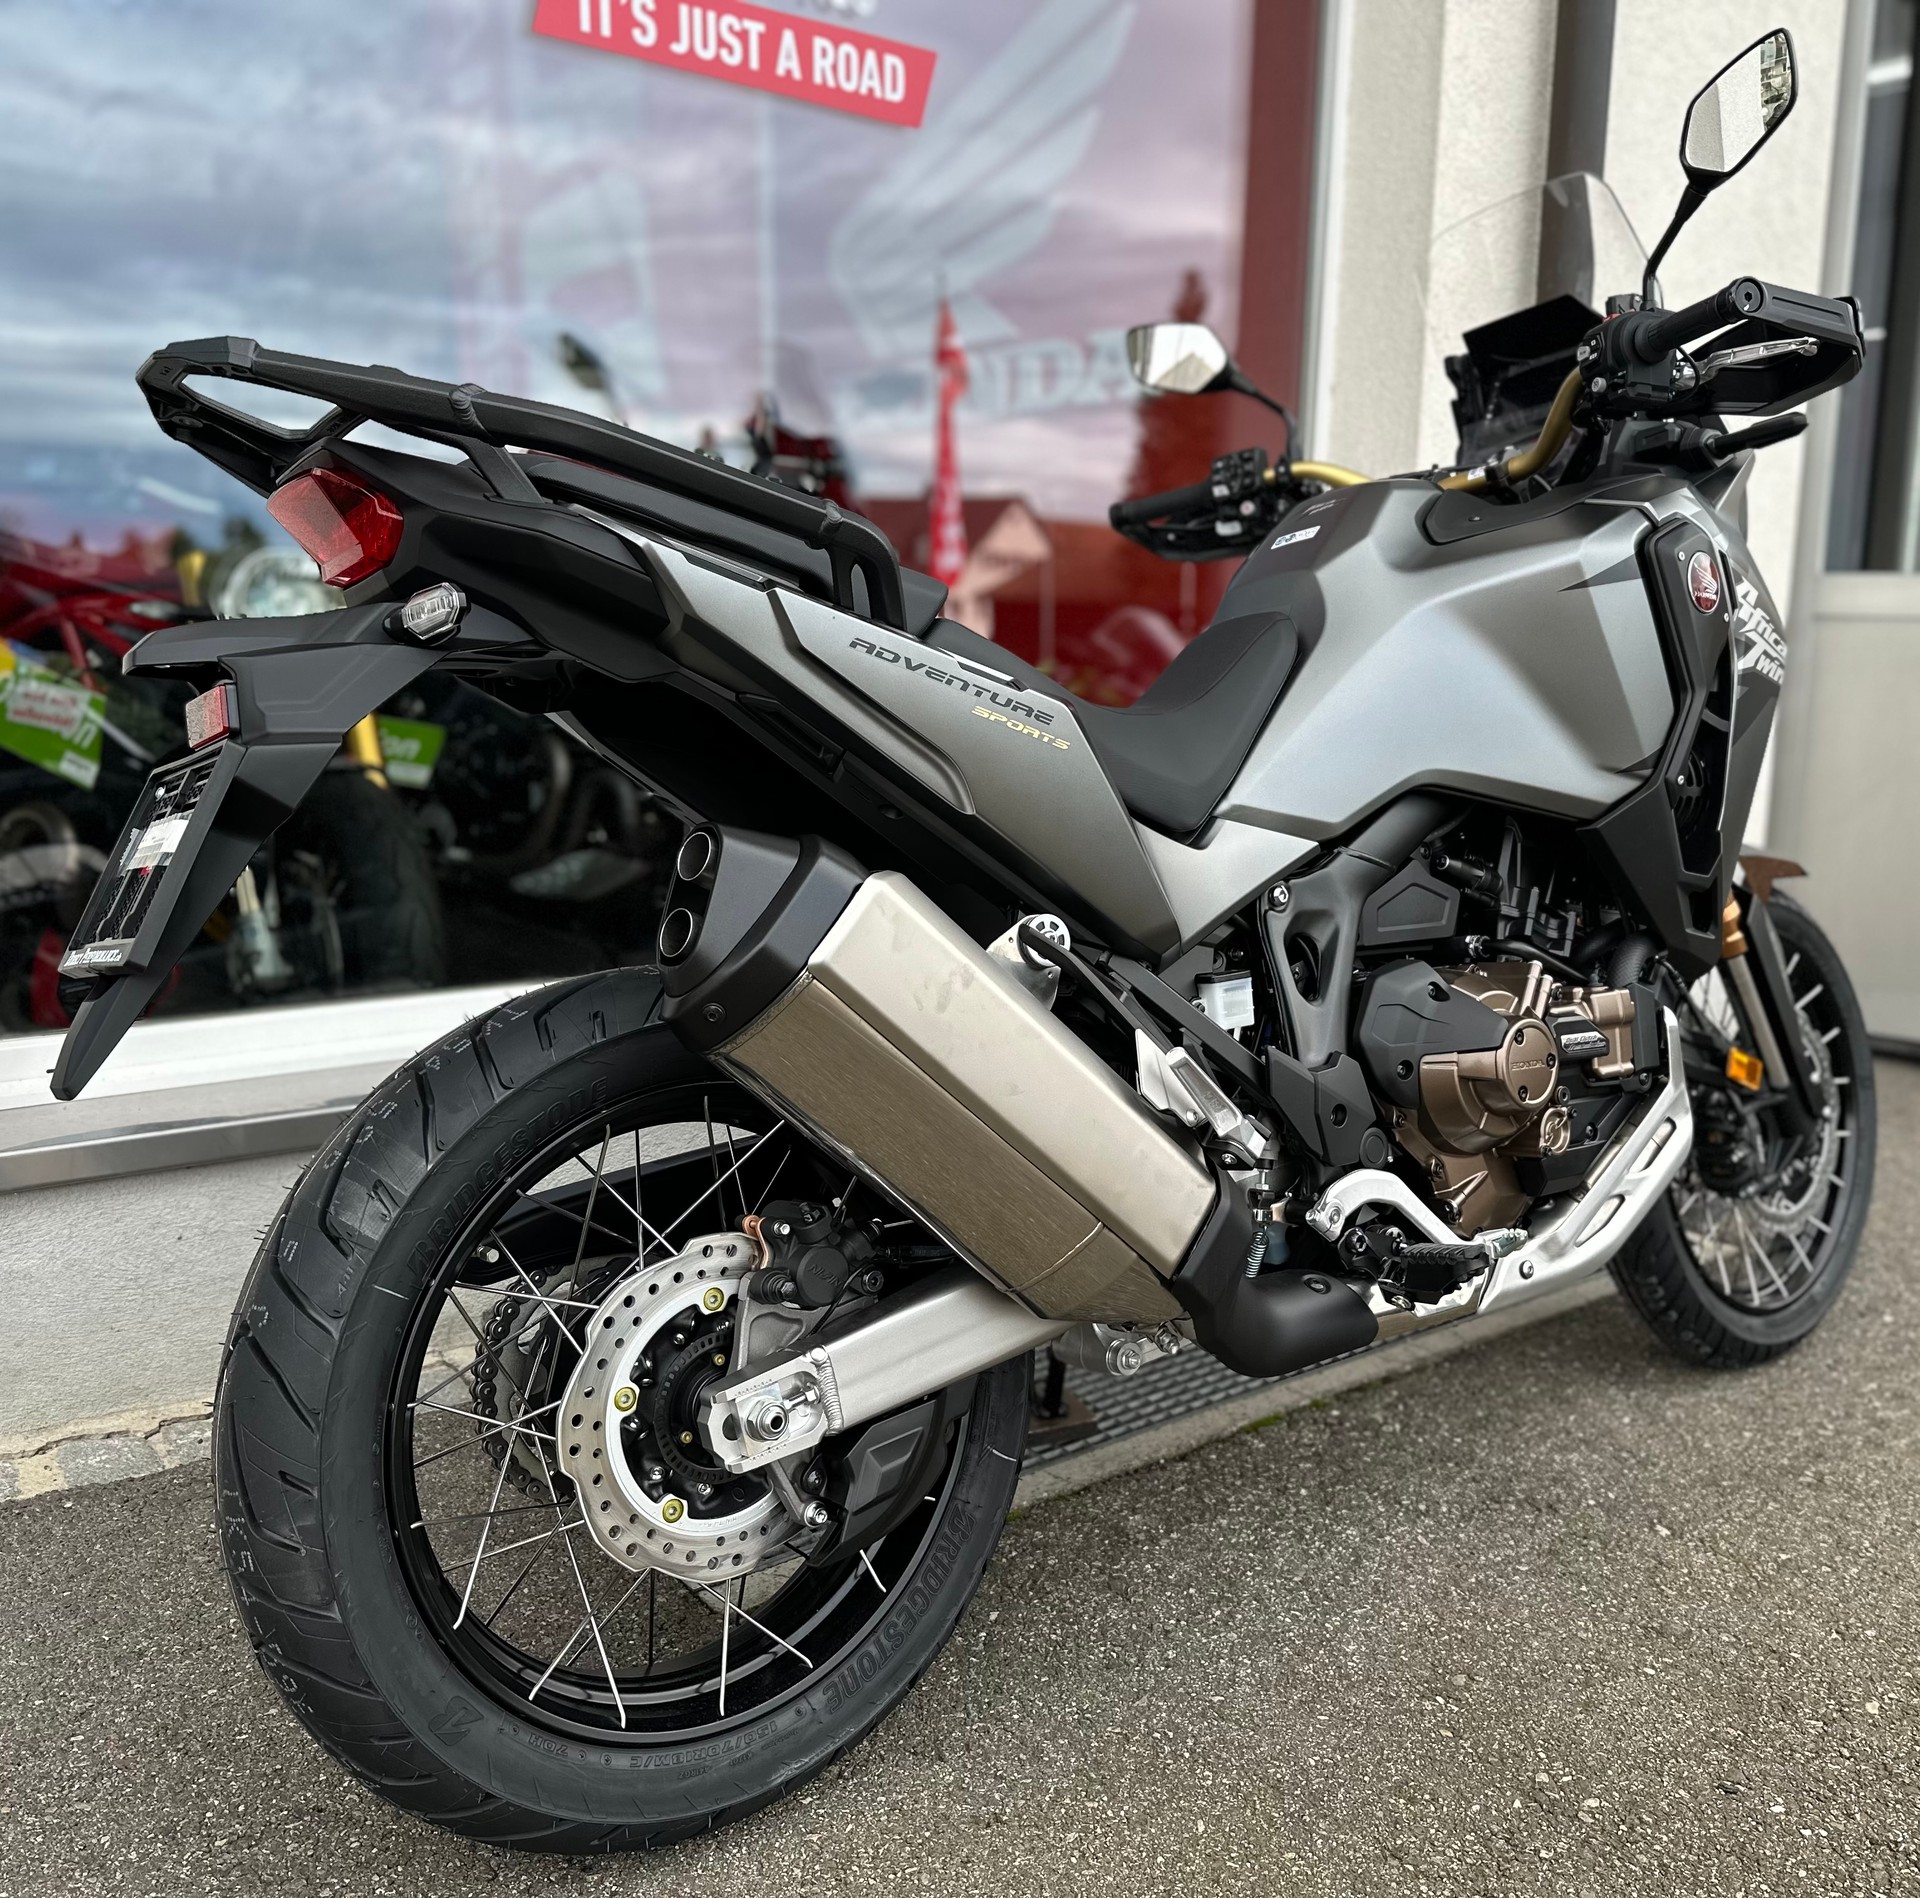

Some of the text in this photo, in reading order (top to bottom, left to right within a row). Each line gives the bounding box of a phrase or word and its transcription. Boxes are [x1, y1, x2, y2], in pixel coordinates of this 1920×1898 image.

[670, 3, 766, 71] JUST
[775, 28, 802, 81] A
[812, 36, 906, 103] ROAD
[849, 637, 1055, 726] ADVENTURE
[971, 705, 1071, 750] SPORTS
[1510, 1058, 1546, 1072] HONDA
[406, 1075, 608, 1276] BRIDGESTONE
[822, 1504, 976, 1714] BRIDGESTONE
[528, 1733, 569, 1757] 70H
[629, 1720, 778, 1769] 150/70R18M/C
